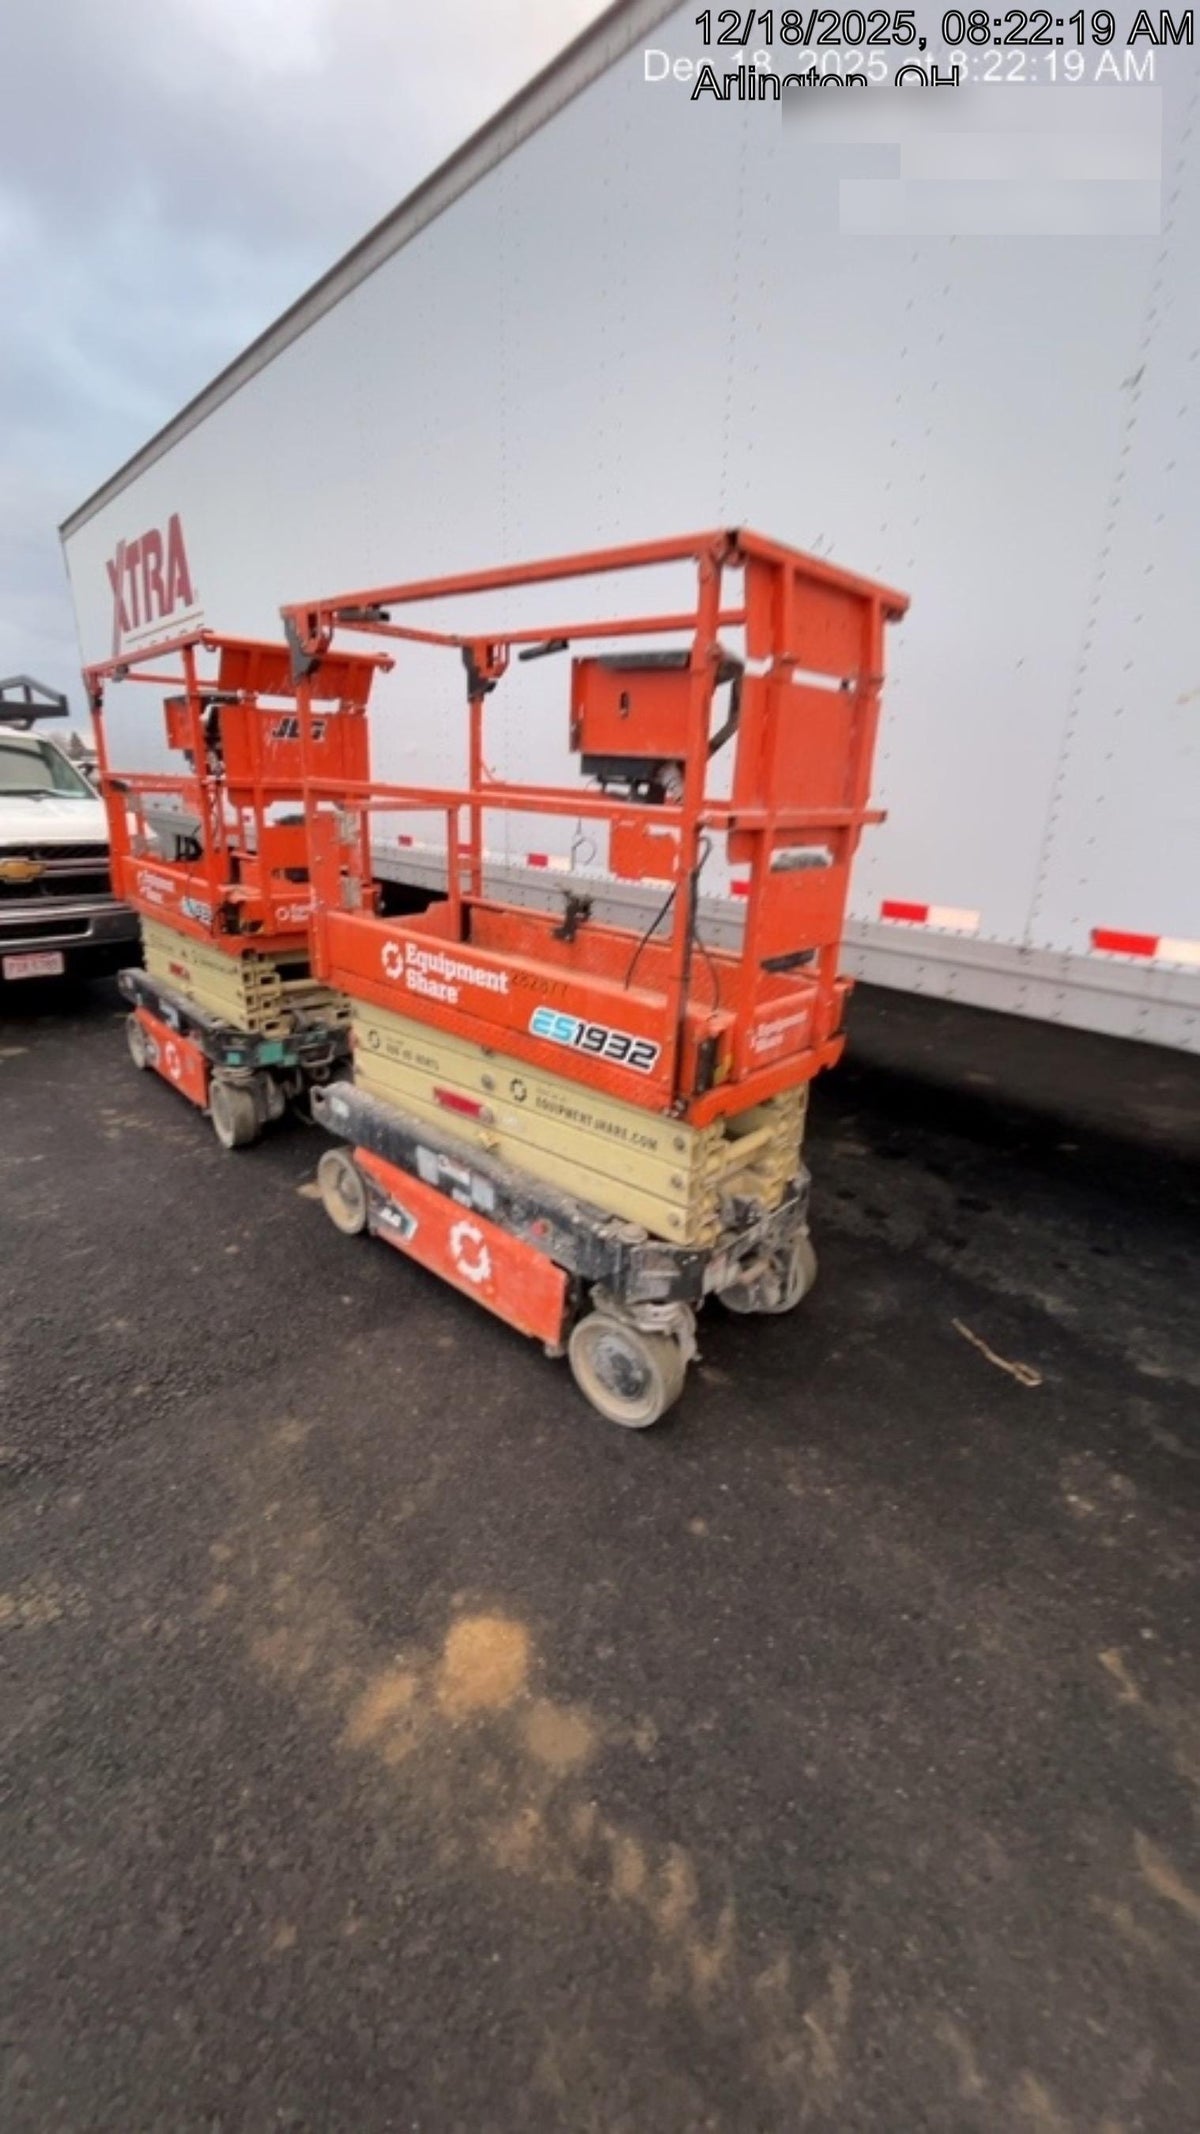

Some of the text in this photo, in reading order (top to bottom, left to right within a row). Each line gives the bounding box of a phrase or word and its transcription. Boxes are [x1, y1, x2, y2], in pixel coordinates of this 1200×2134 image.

[106, 512, 194, 633] XTRA
[405, 943, 509, 994] Equipment
[406, 971, 459, 1003] Share
[533, 1010, 659, 1071] ES1932
